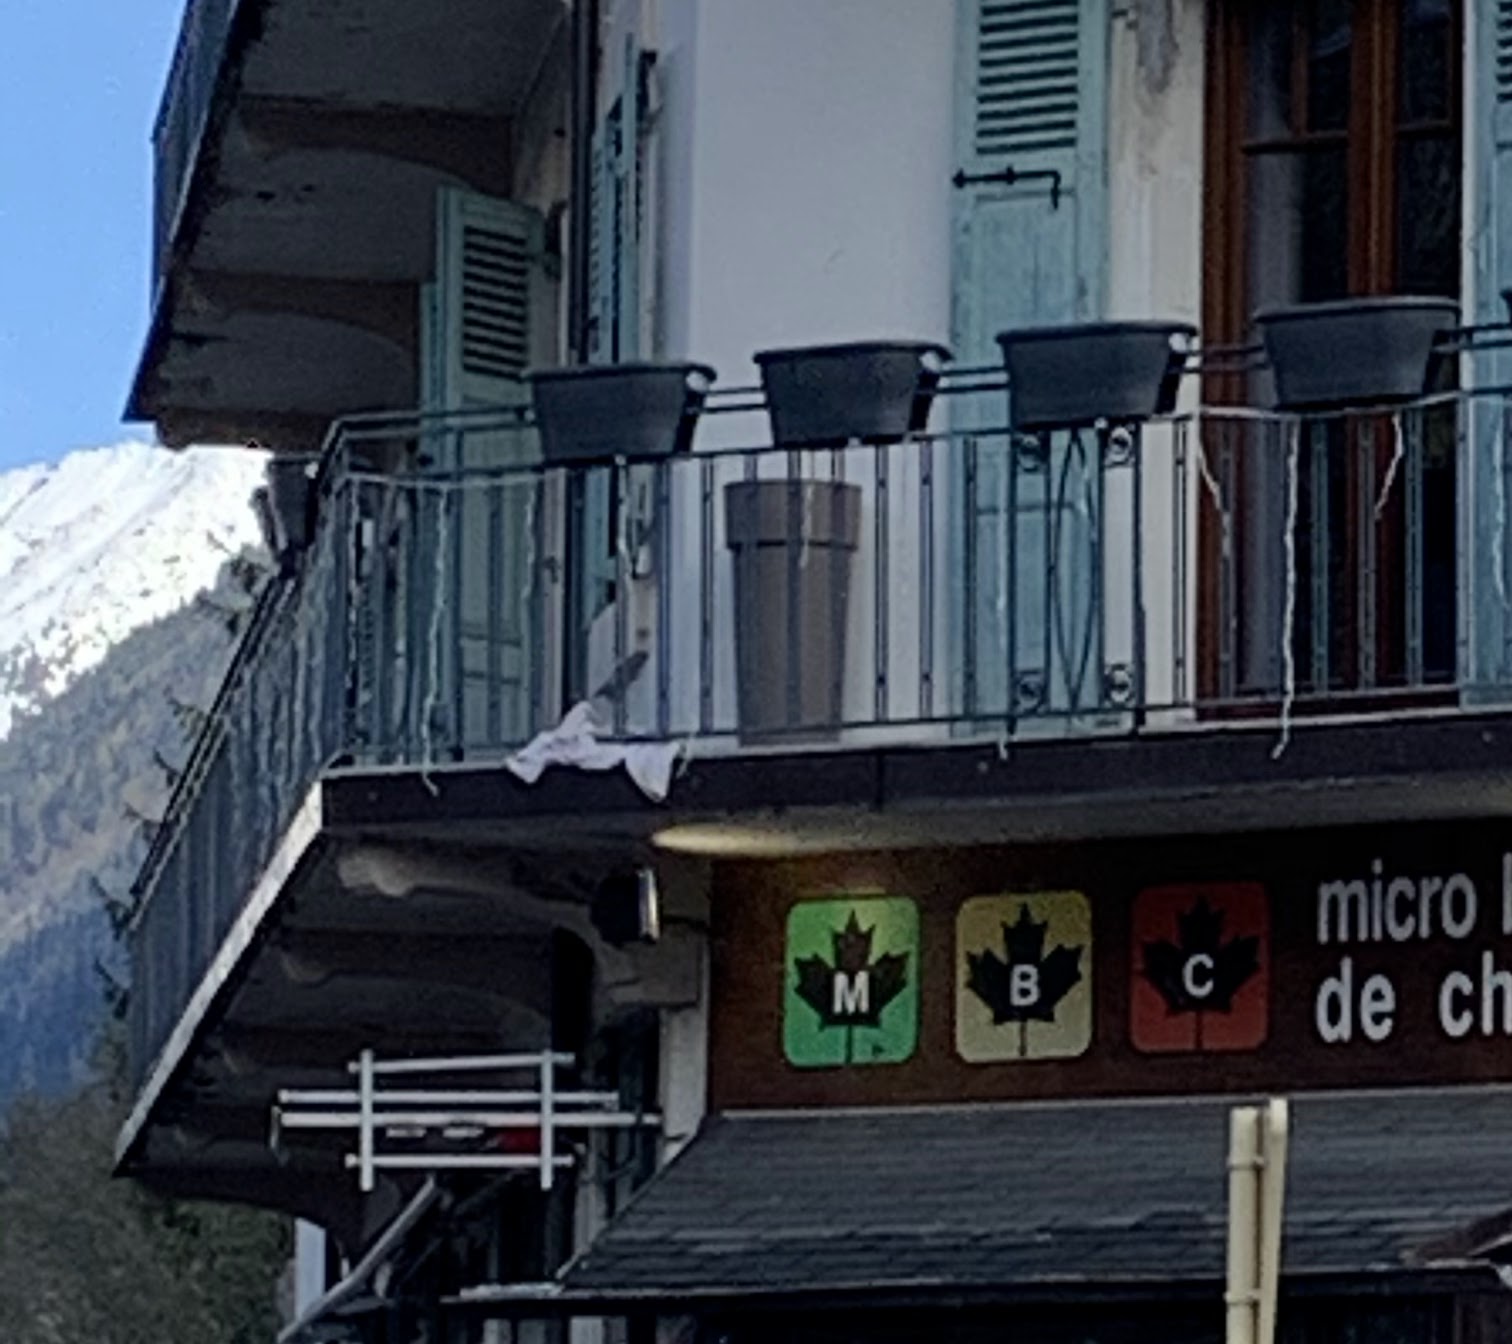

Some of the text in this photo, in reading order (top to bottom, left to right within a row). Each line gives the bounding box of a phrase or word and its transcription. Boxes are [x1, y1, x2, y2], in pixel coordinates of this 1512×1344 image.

[1317, 858, 1478, 944] micro
[833, 953, 1214, 1014] M B C
[1316, 956, 1396, 1043] de
